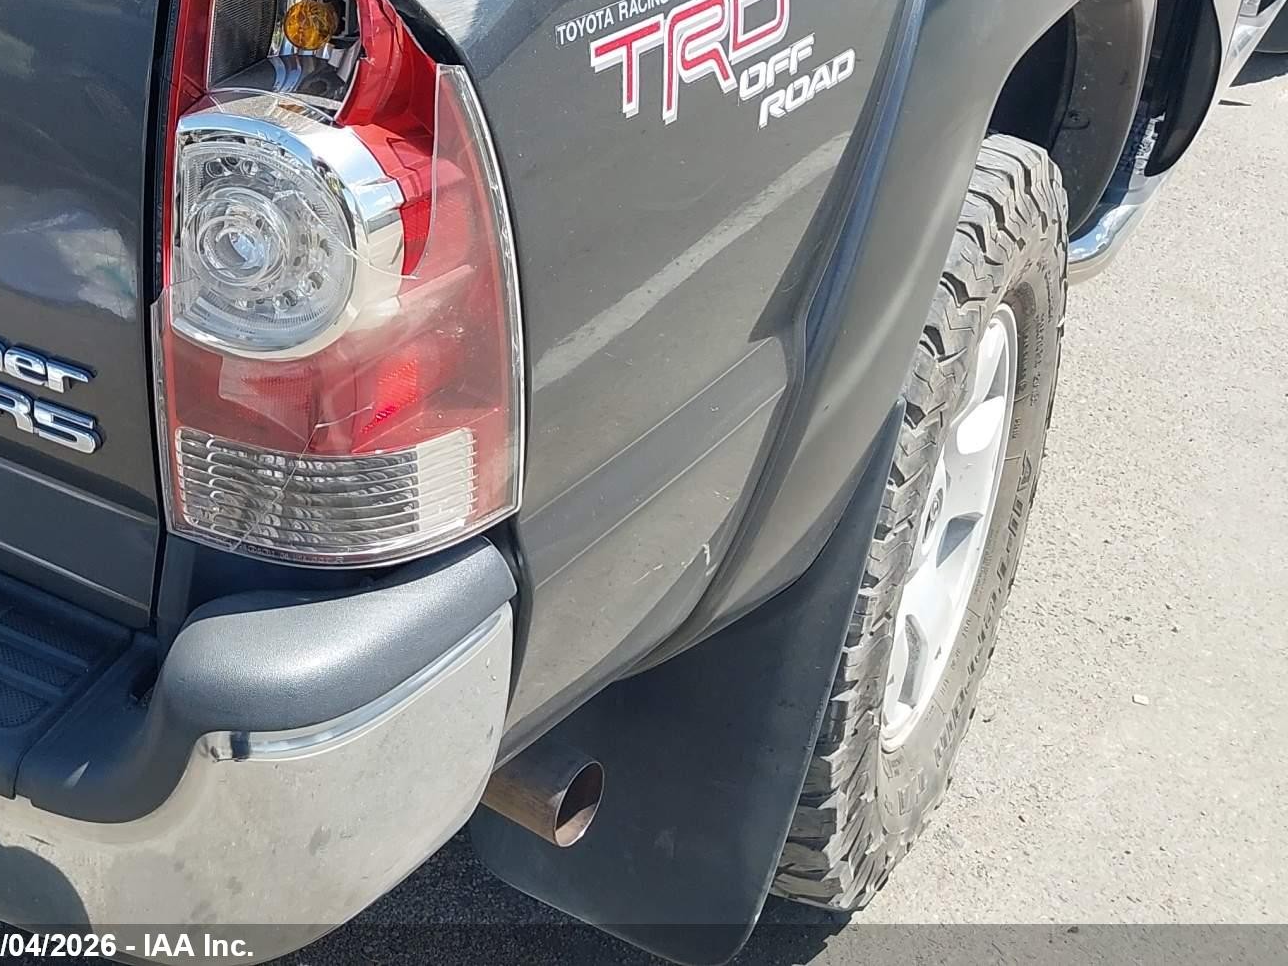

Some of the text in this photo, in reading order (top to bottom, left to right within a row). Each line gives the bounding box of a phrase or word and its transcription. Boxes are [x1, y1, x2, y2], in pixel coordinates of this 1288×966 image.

[556, 10, 615, 45] TOYOTA
[739, 33, 815, 101] OFF
[758, 48, 856, 130] ROAD
